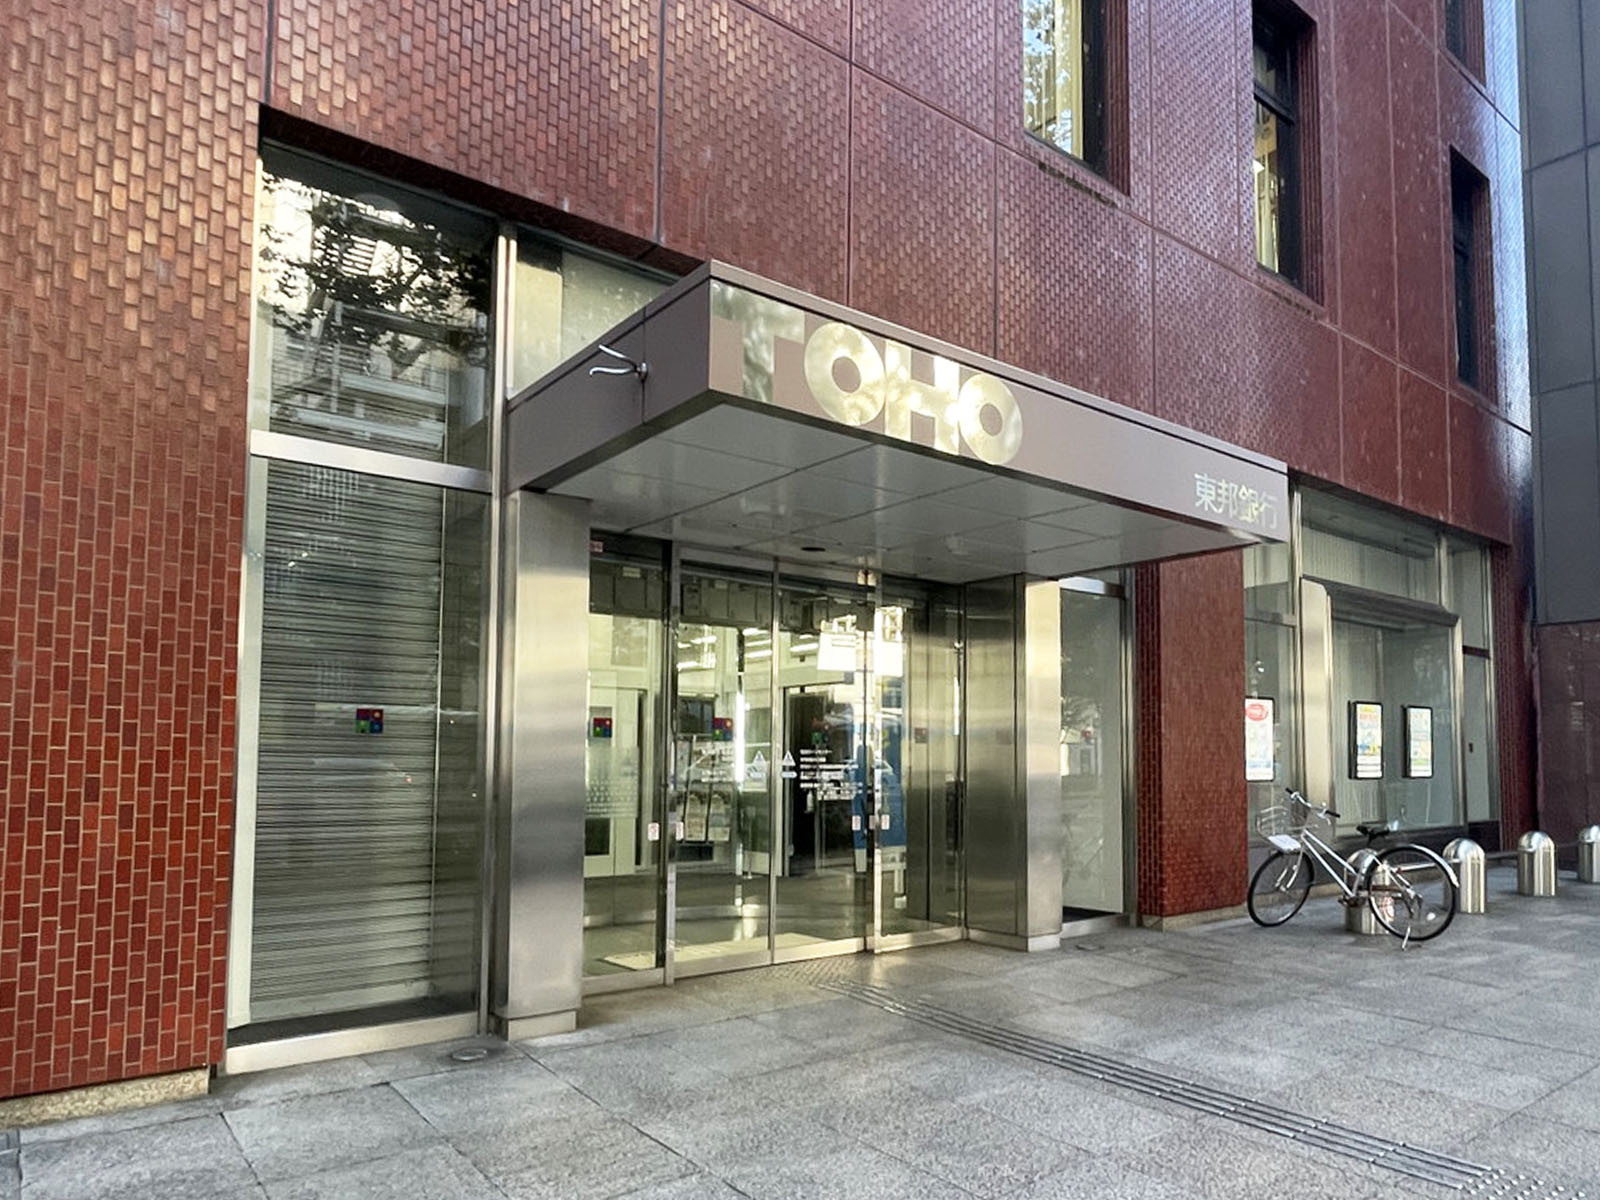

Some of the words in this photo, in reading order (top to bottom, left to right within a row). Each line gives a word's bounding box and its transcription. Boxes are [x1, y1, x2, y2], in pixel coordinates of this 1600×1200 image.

[710, 281, 1023, 466] TOHO
[1194, 473, 1278, 529] 東邦銀行
